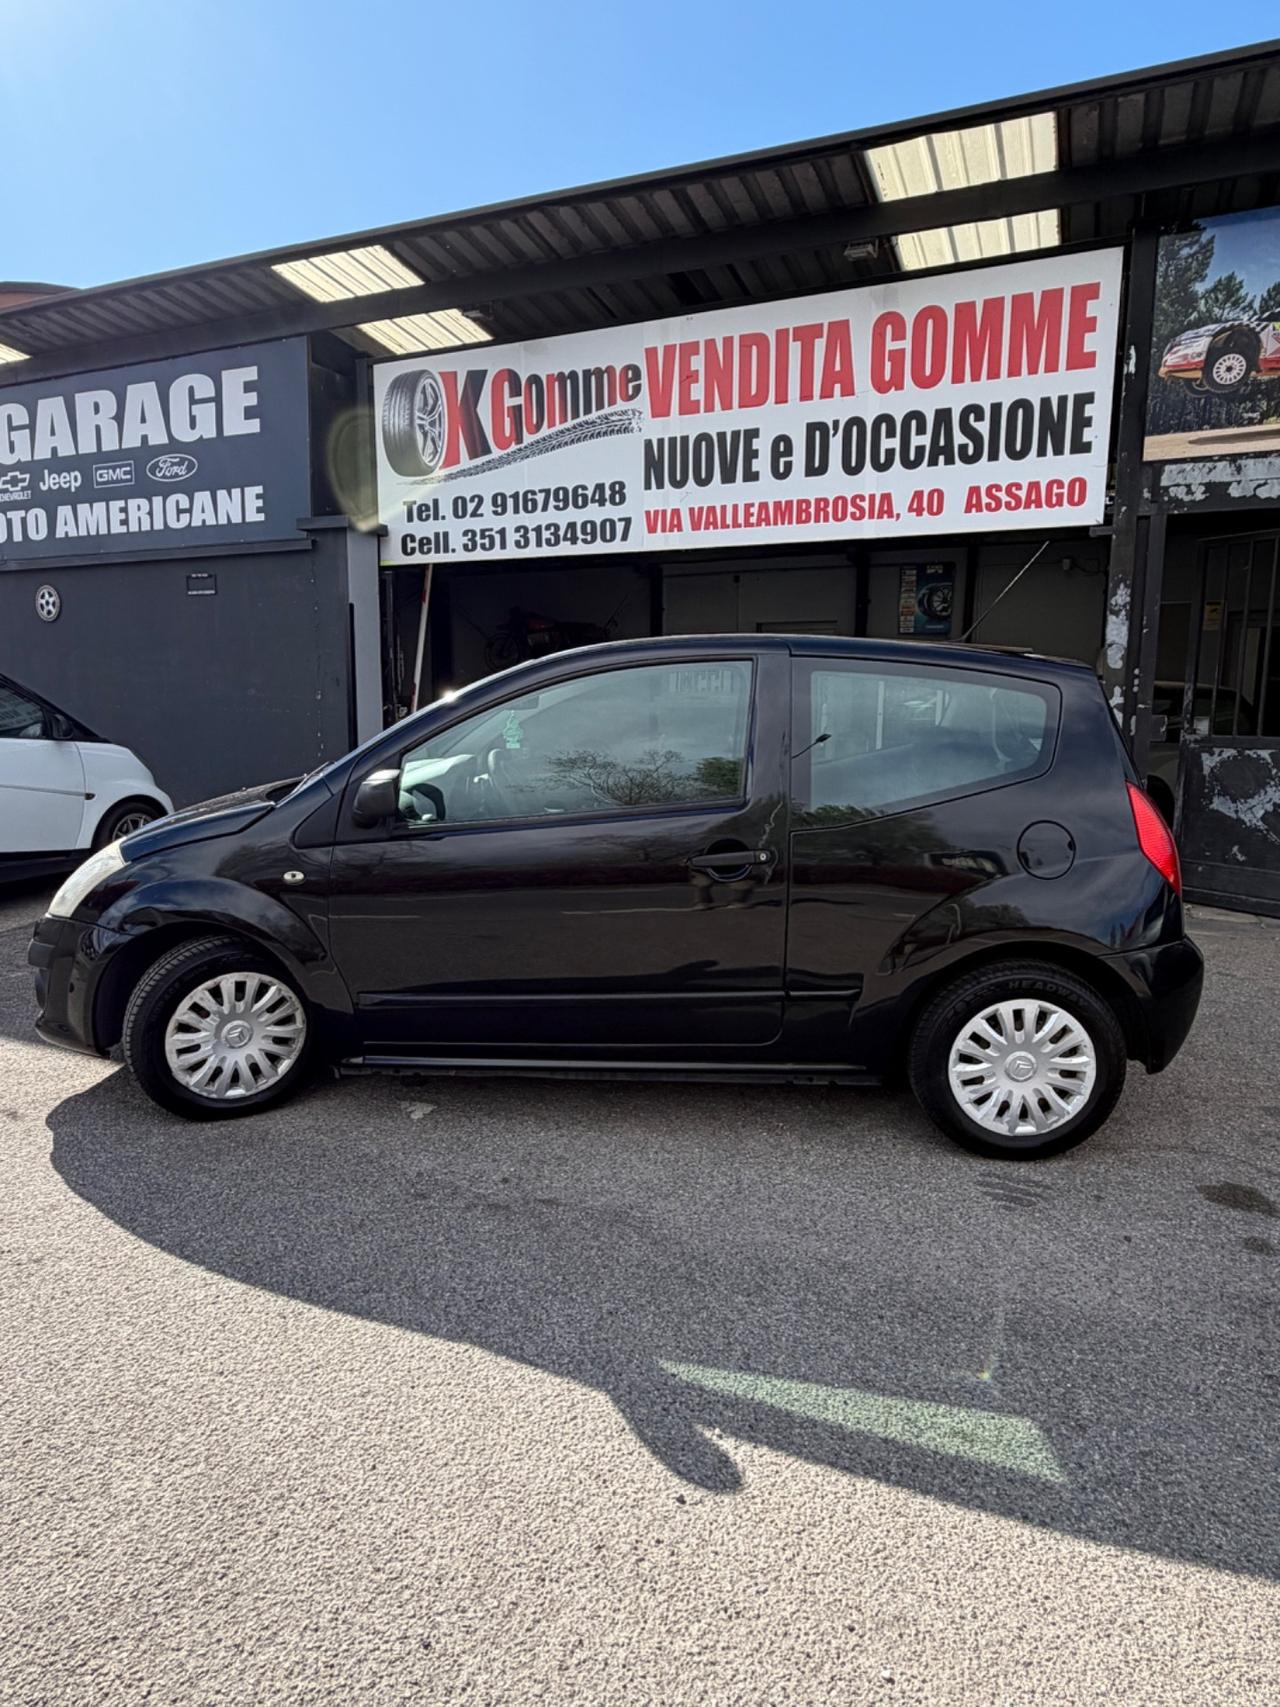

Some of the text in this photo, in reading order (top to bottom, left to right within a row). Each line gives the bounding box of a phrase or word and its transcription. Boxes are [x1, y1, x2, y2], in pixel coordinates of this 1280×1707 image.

[644, 282, 1101, 419] VENDITA GOMME
[0, 366, 261, 466] GARAGE
[39, 469, 82, 492] Jeep
[96, 466, 131, 482] GMC
[155, 457, 188, 477] Ford
[643, 427, 761, 492] NUOVE
[770, 434, 794, 481] e
[55, 486, 265, 538] AMERICANE
[402, 480, 627, 524] Tel. 02 91679648
[644, 477, 1088, 535] VIA VALLEAMBROSIA, 40 ASSAGO
[401, 517, 633, 556] Cell. 351 3134907
